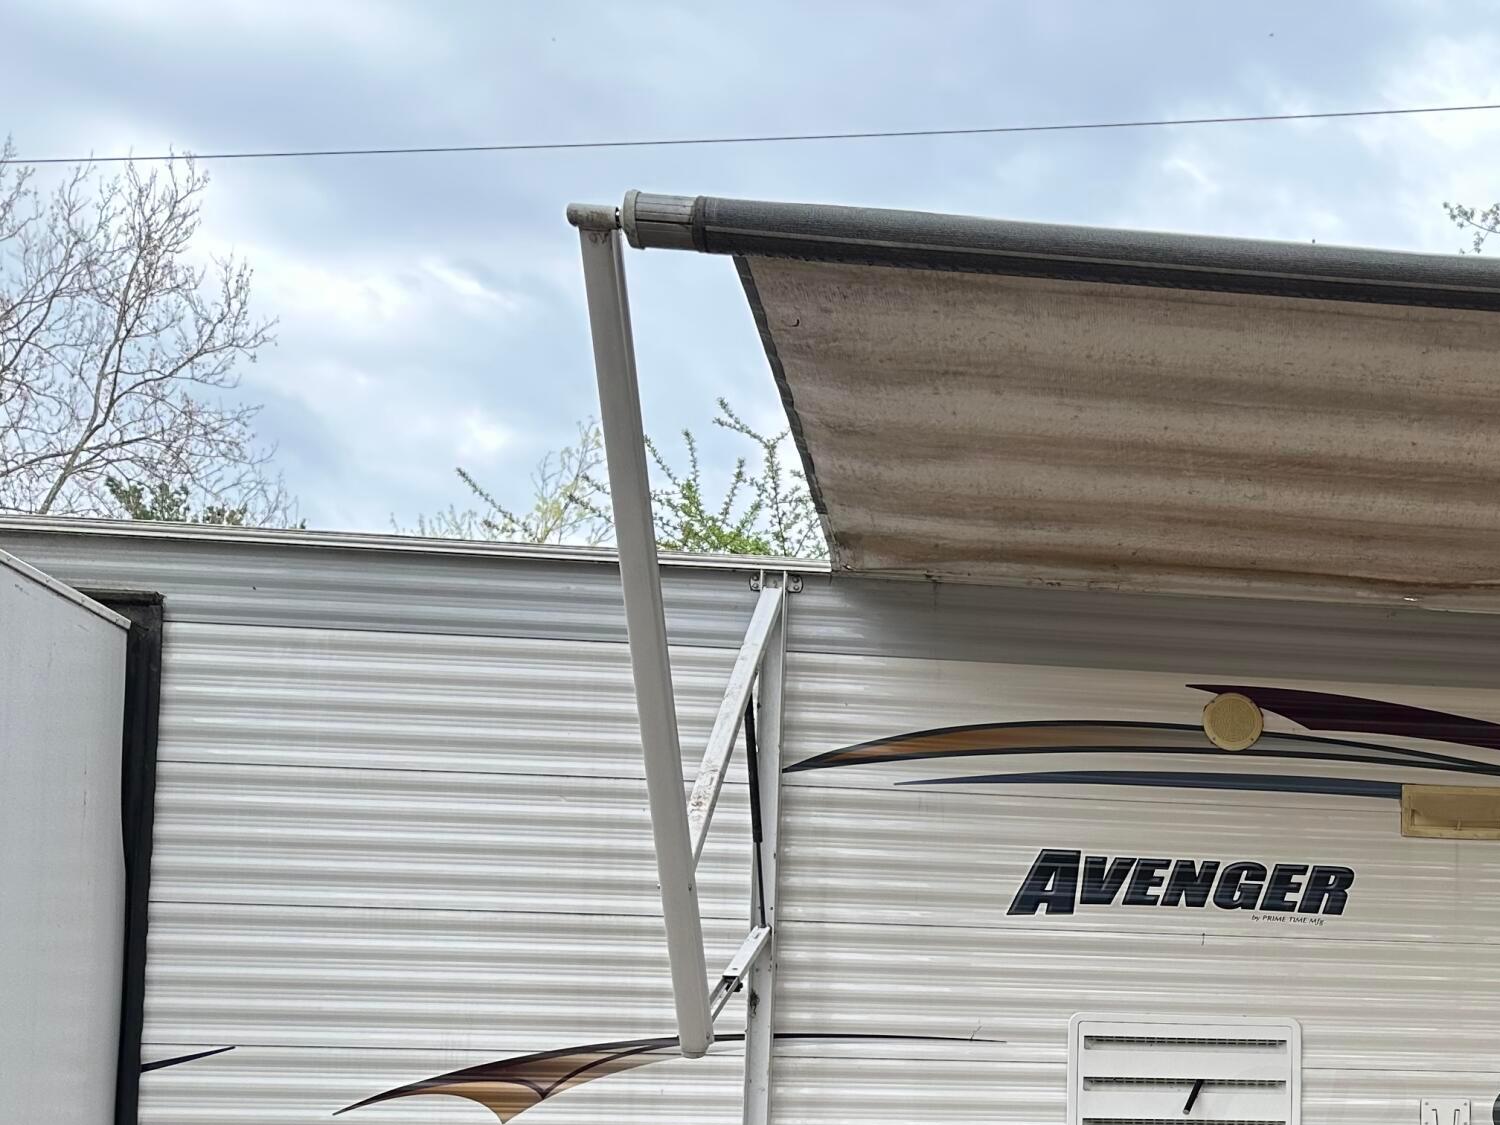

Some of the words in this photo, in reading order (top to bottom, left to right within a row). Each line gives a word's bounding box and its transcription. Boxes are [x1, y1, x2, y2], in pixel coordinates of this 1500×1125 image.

[1006, 848, 1355, 915] AVENGER
[1251, 914, 1260, 922] by
[1262, 914, 1286, 923] PRIME
[1289, 916, 1308, 924] TIME
